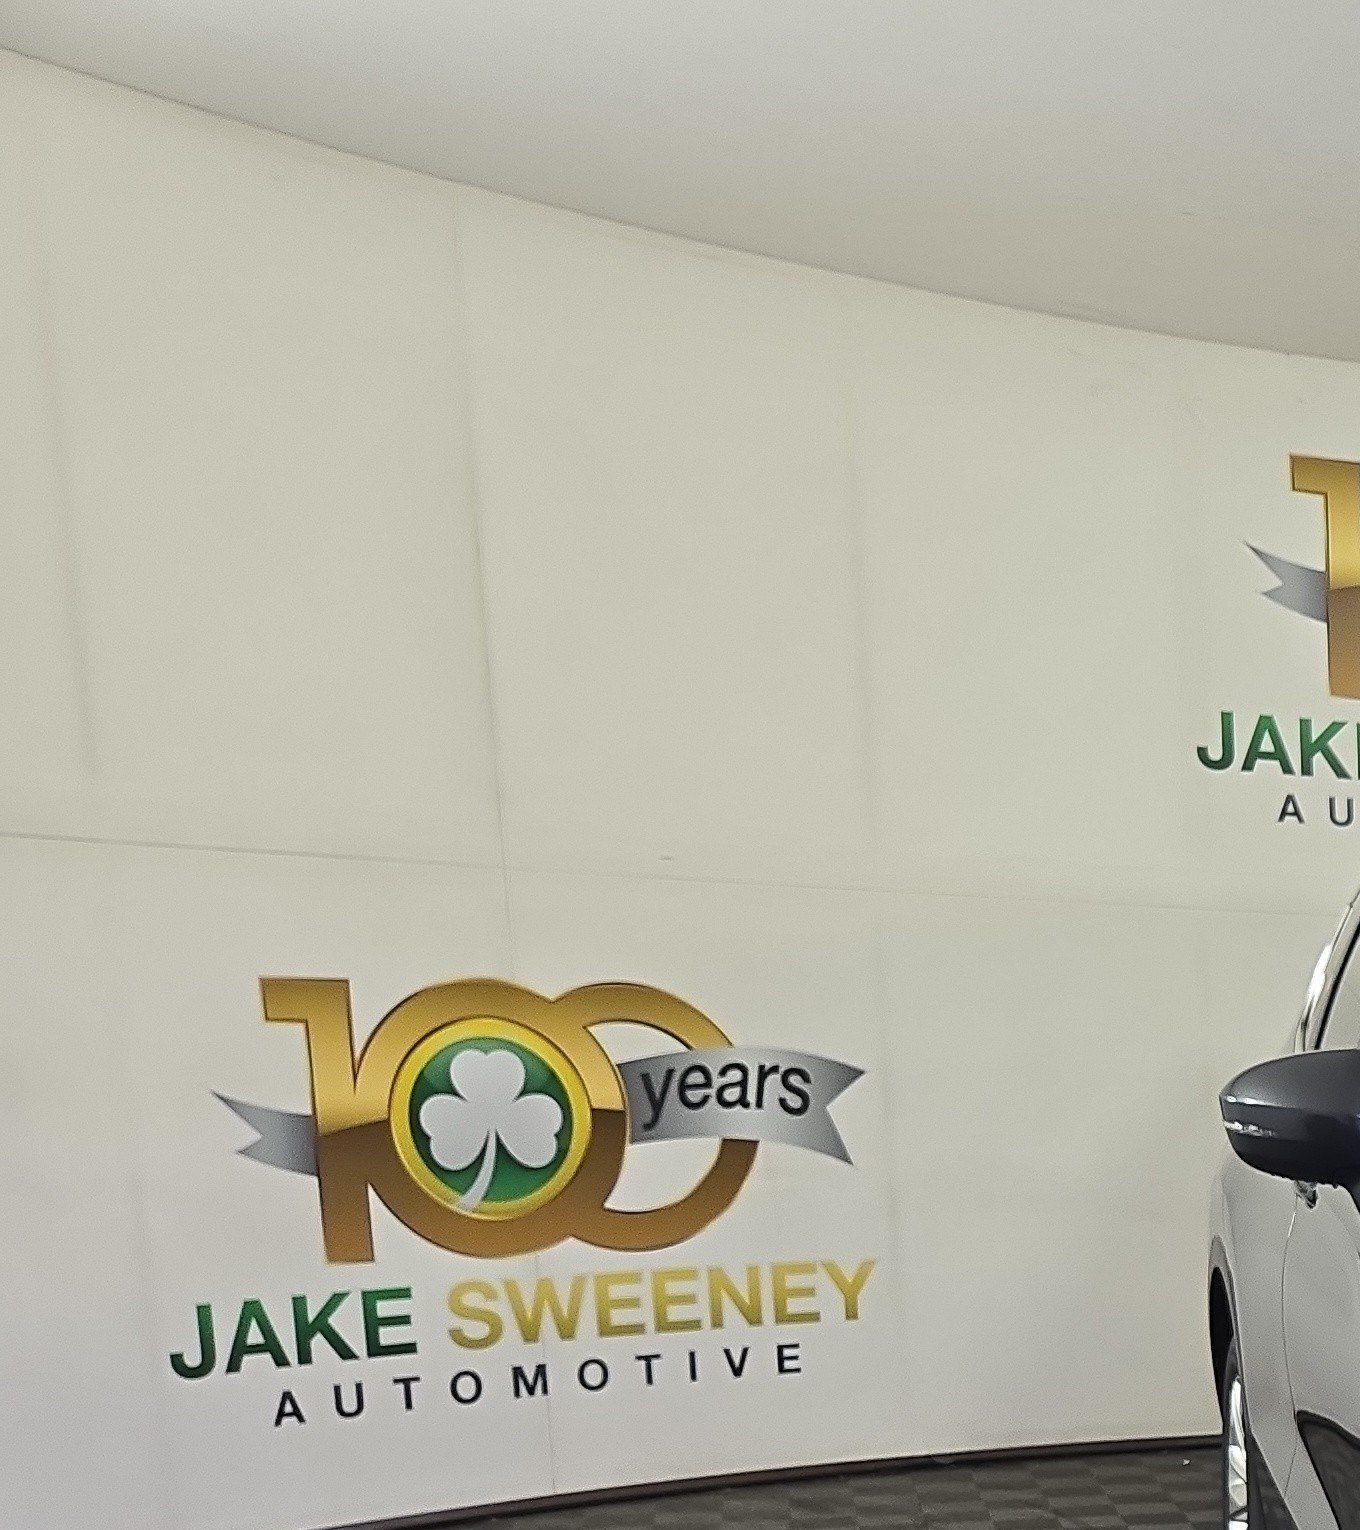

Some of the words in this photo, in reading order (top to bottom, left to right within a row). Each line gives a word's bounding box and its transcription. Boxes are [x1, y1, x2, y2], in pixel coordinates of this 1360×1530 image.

[640, 1060, 813, 1130] years
[169, 1286, 418, 1380] JAKE
[446, 1258, 877, 1351] SWEENEY
[273, 1343, 803, 1427] AUTOMOTIVE
